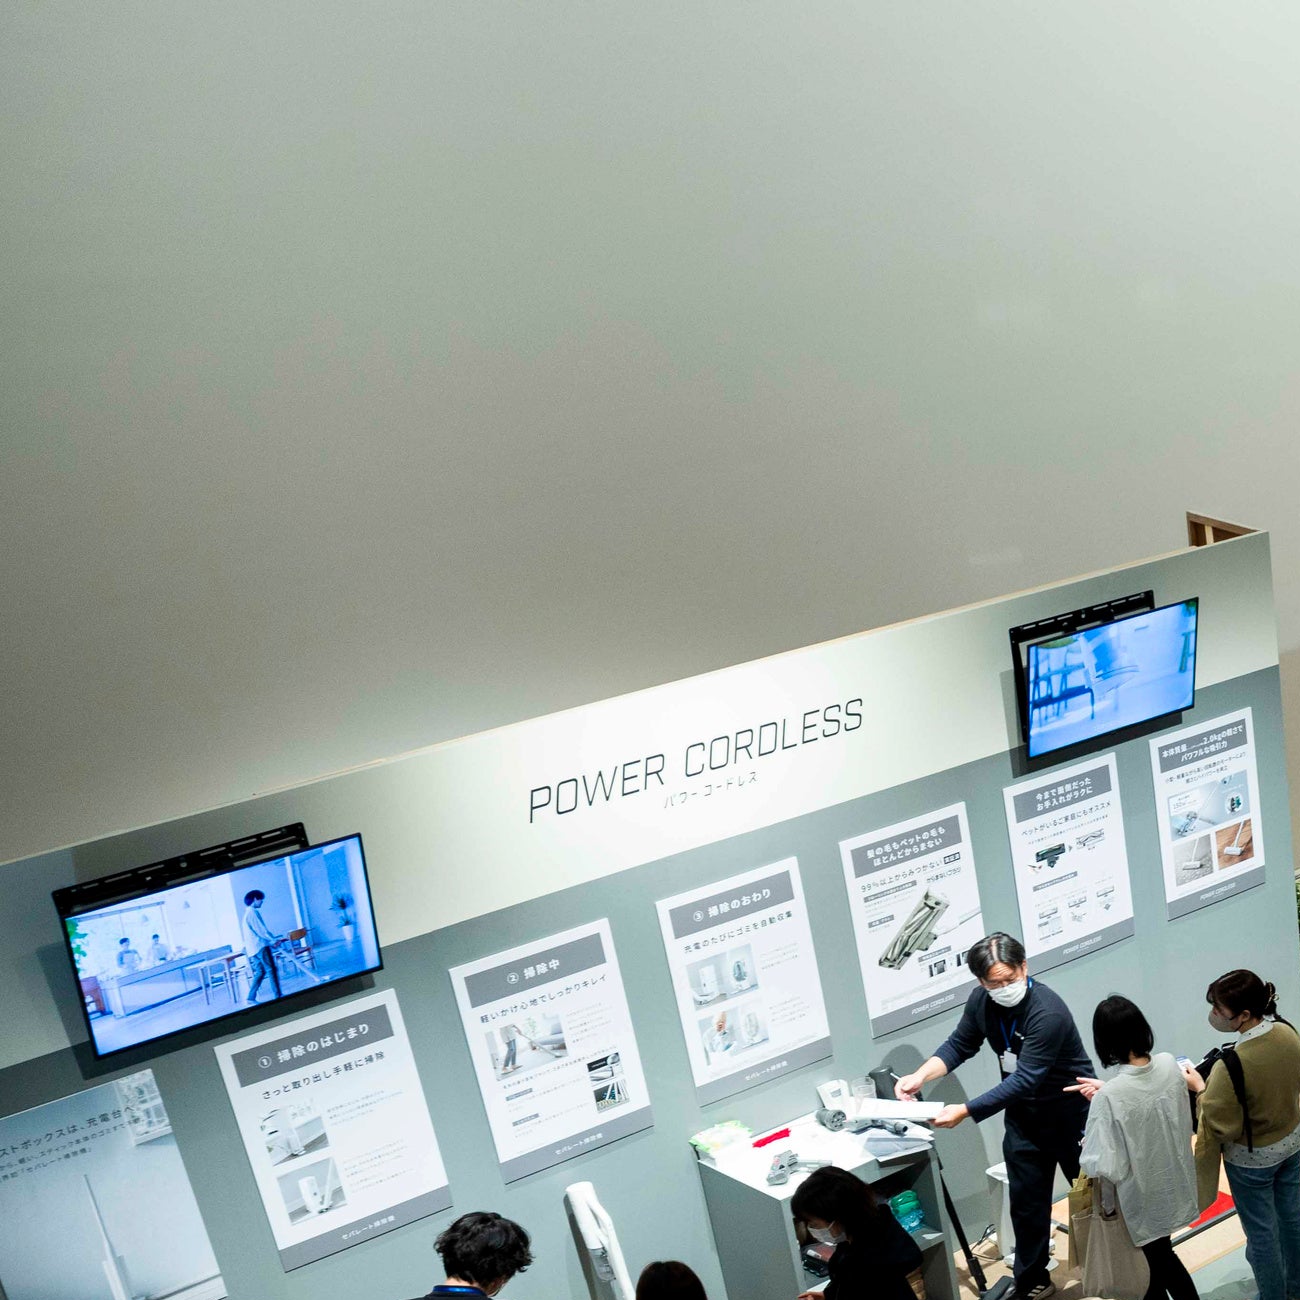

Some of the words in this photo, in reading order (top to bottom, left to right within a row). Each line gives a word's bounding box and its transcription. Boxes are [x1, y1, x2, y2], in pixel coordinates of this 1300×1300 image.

[529, 753, 666, 824] POWER
[685, 698, 864, 778] CORDLESS
[1036, 786, 1093, 812] お手入れがラクに
[707, 887, 772, 919] 掃除のおわり
[523, 958, 561, 981] 掃除中
[480, 973, 607, 1024] 軽いかけ心地でしっかりキレイ
[276, 1023, 370, 1063] 掃除のはじまり
[262, 1050, 386, 1100] さっと取り出し手軽に掃除
